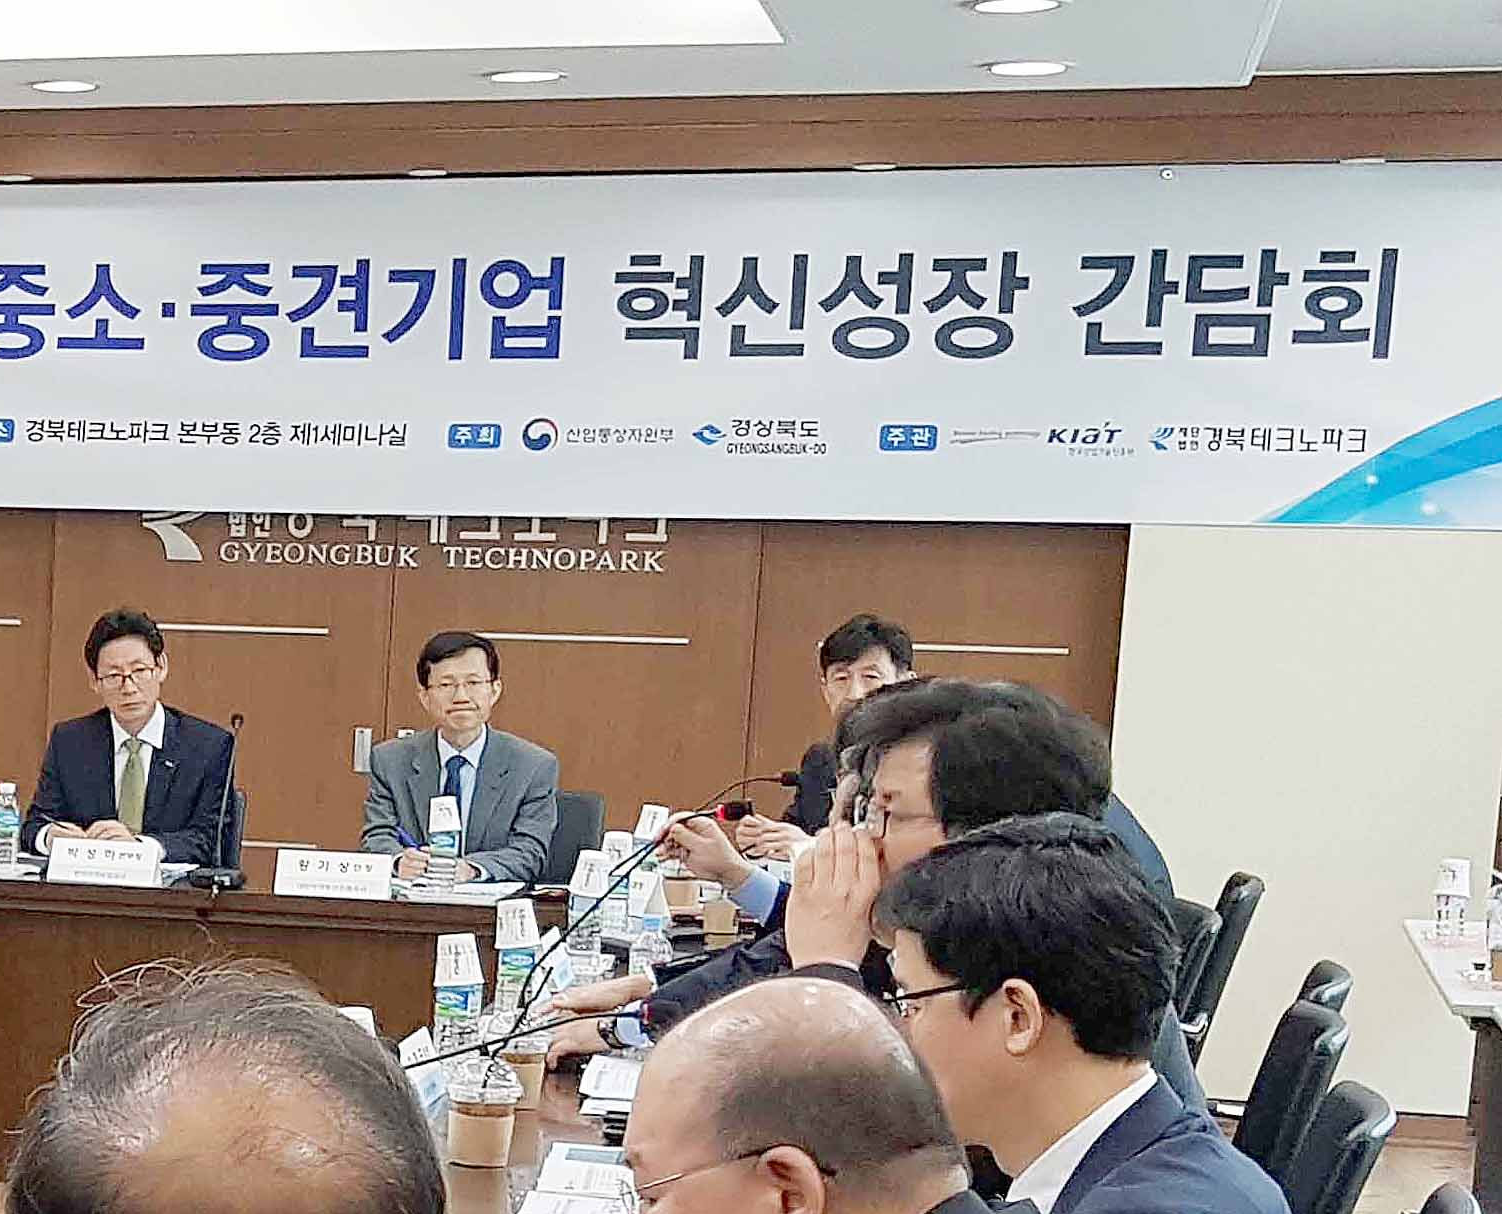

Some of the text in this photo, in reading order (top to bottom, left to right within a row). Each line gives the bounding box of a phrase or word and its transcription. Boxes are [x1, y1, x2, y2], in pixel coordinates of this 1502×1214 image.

[614, 250, 1029, 360] 혁신성장
[1073, 246, 1400, 360] 간담회
[26, 419, 170, 442] 경북테크노파크
[177, 420, 239, 444] 본부동
[248, 421, 282, 445] 2층
[290, 422, 408, 447] 제1세미나실
[454, 426, 674, 445] 주최 산업통상자원부
[732, 419, 819, 438] 경상북도
[887, 427, 932, 447] 주관
[1203, 426, 1367, 452] 경북테크노파크
[219, 540, 667, 572] GYEONGBUK TECHNOPARK
